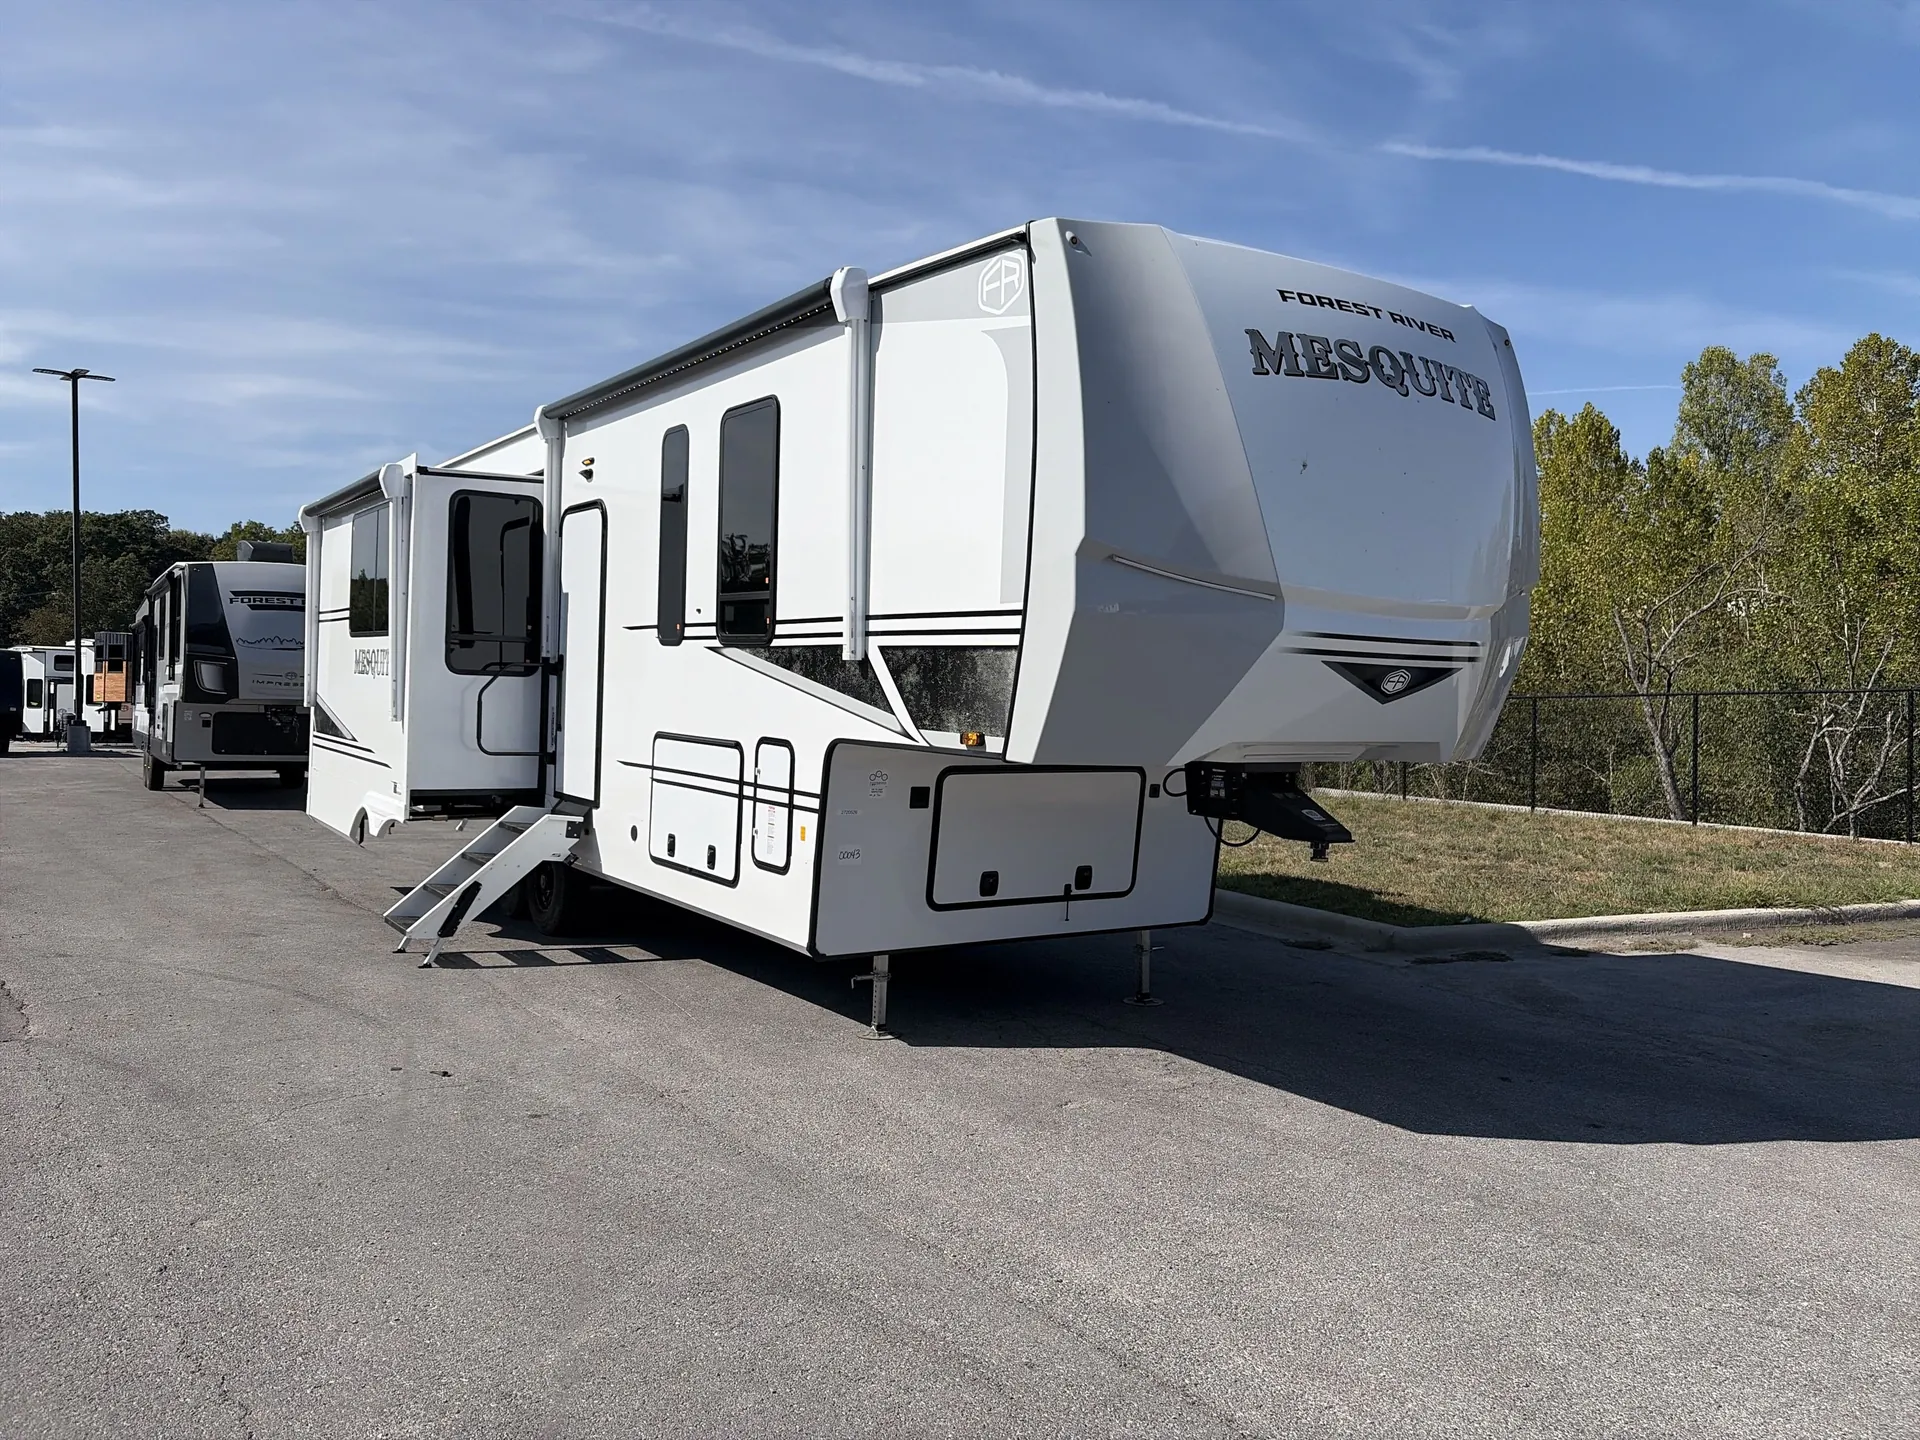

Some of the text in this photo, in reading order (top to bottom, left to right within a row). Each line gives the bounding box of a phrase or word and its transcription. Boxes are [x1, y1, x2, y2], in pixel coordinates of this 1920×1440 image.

[1276, 289, 1457, 344] FOREST RIVER
[1244, 328, 1497, 422] MESQUITE
[229, 597, 297, 605] FOREST
[354, 649, 390, 679] MESQUIT
[839, 848, 861, 860] 00043
